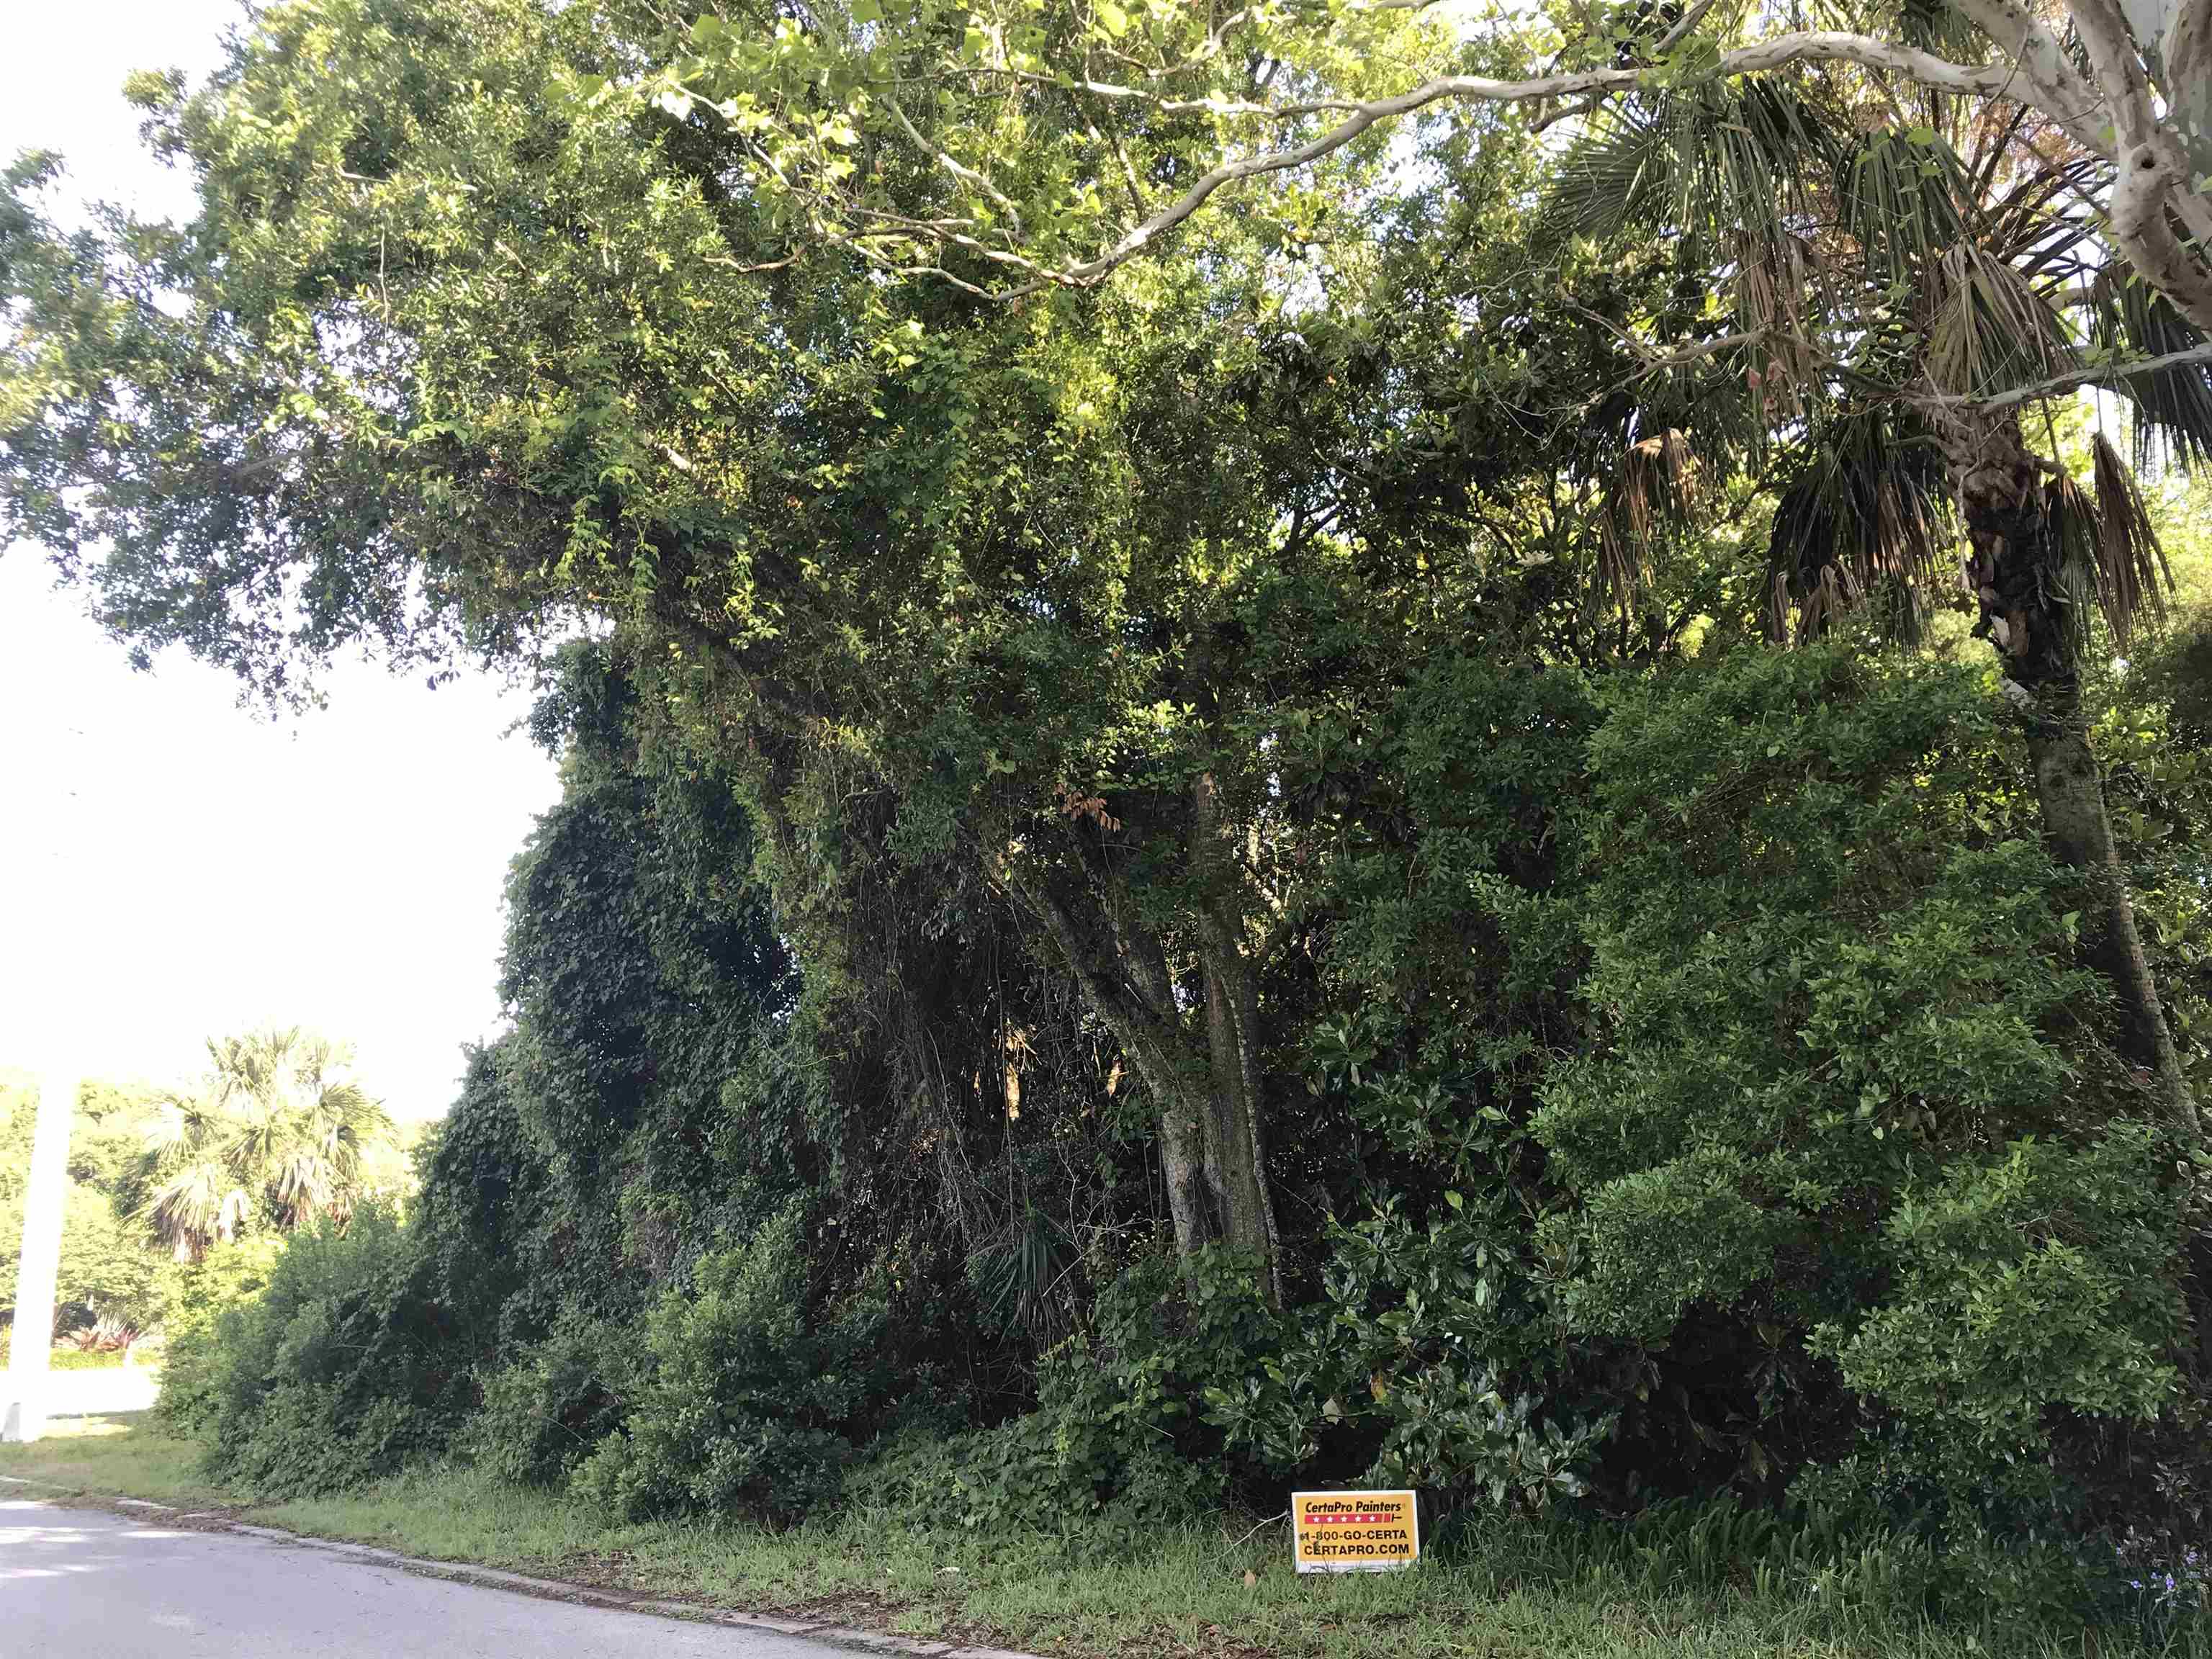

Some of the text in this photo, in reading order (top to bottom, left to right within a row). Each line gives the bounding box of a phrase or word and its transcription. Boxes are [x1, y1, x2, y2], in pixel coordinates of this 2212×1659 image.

[1305, 1501, 1401, 1513] CertaPro Painters
[1304, 1544, 1409, 1555] CERTAPRO.COM
